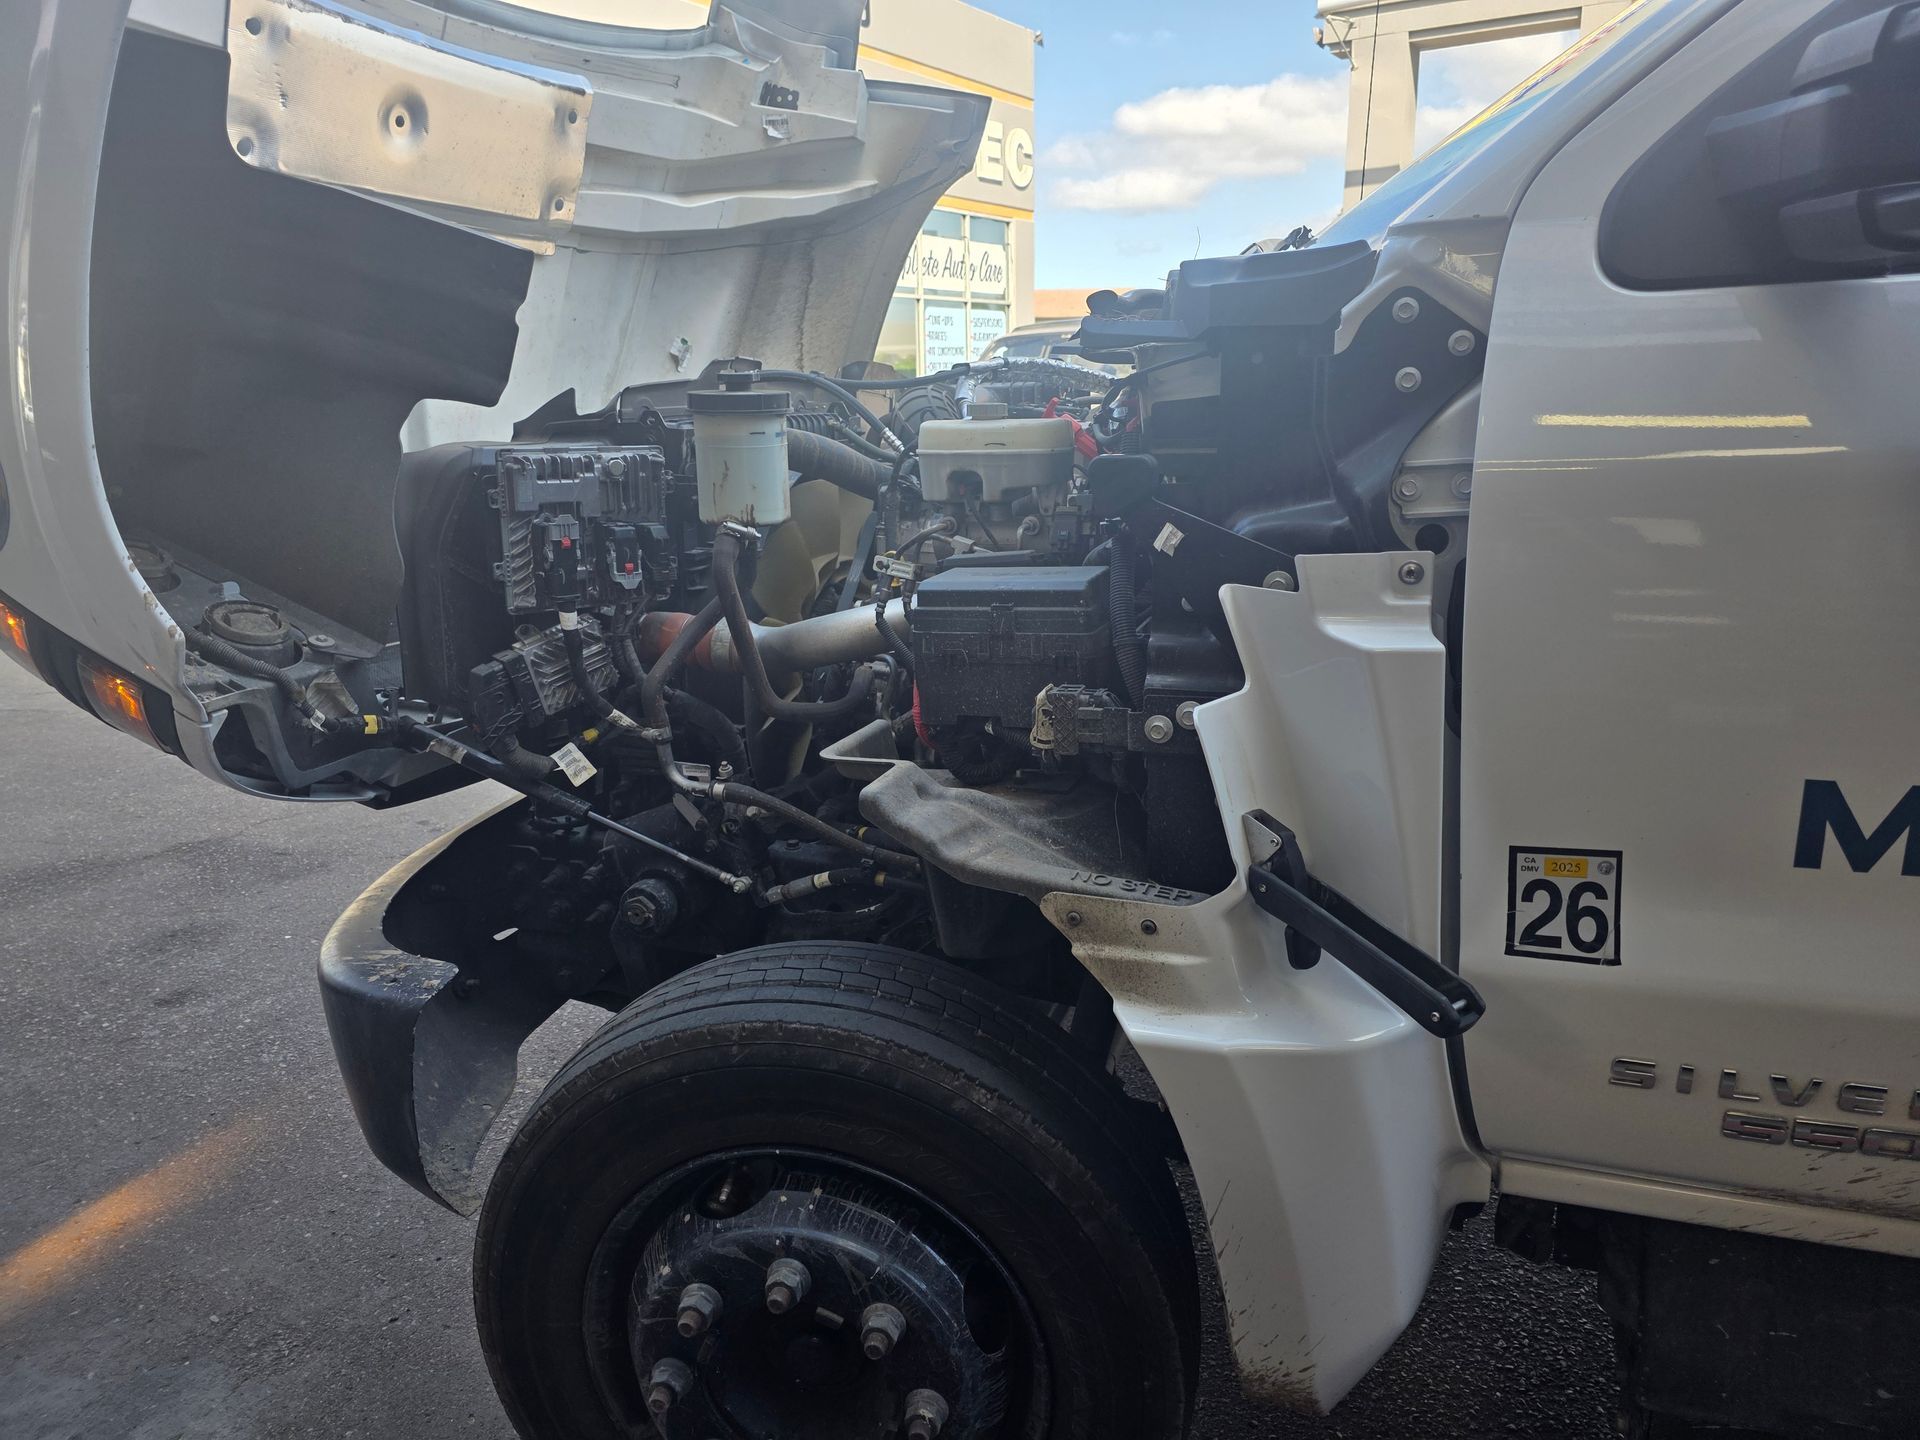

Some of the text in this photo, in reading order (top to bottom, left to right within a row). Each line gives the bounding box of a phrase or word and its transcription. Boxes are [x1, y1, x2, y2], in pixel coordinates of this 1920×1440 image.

[942, 247, 975, 280] Auto
[980, 251, 1003, 283] Care
[1551, 862, 1581, 873] 2025
[1070, 871, 1192, 901] NO STEP
[1519, 878, 1609, 954] 26
[1608, 1057, 1920, 1120] SILVE
